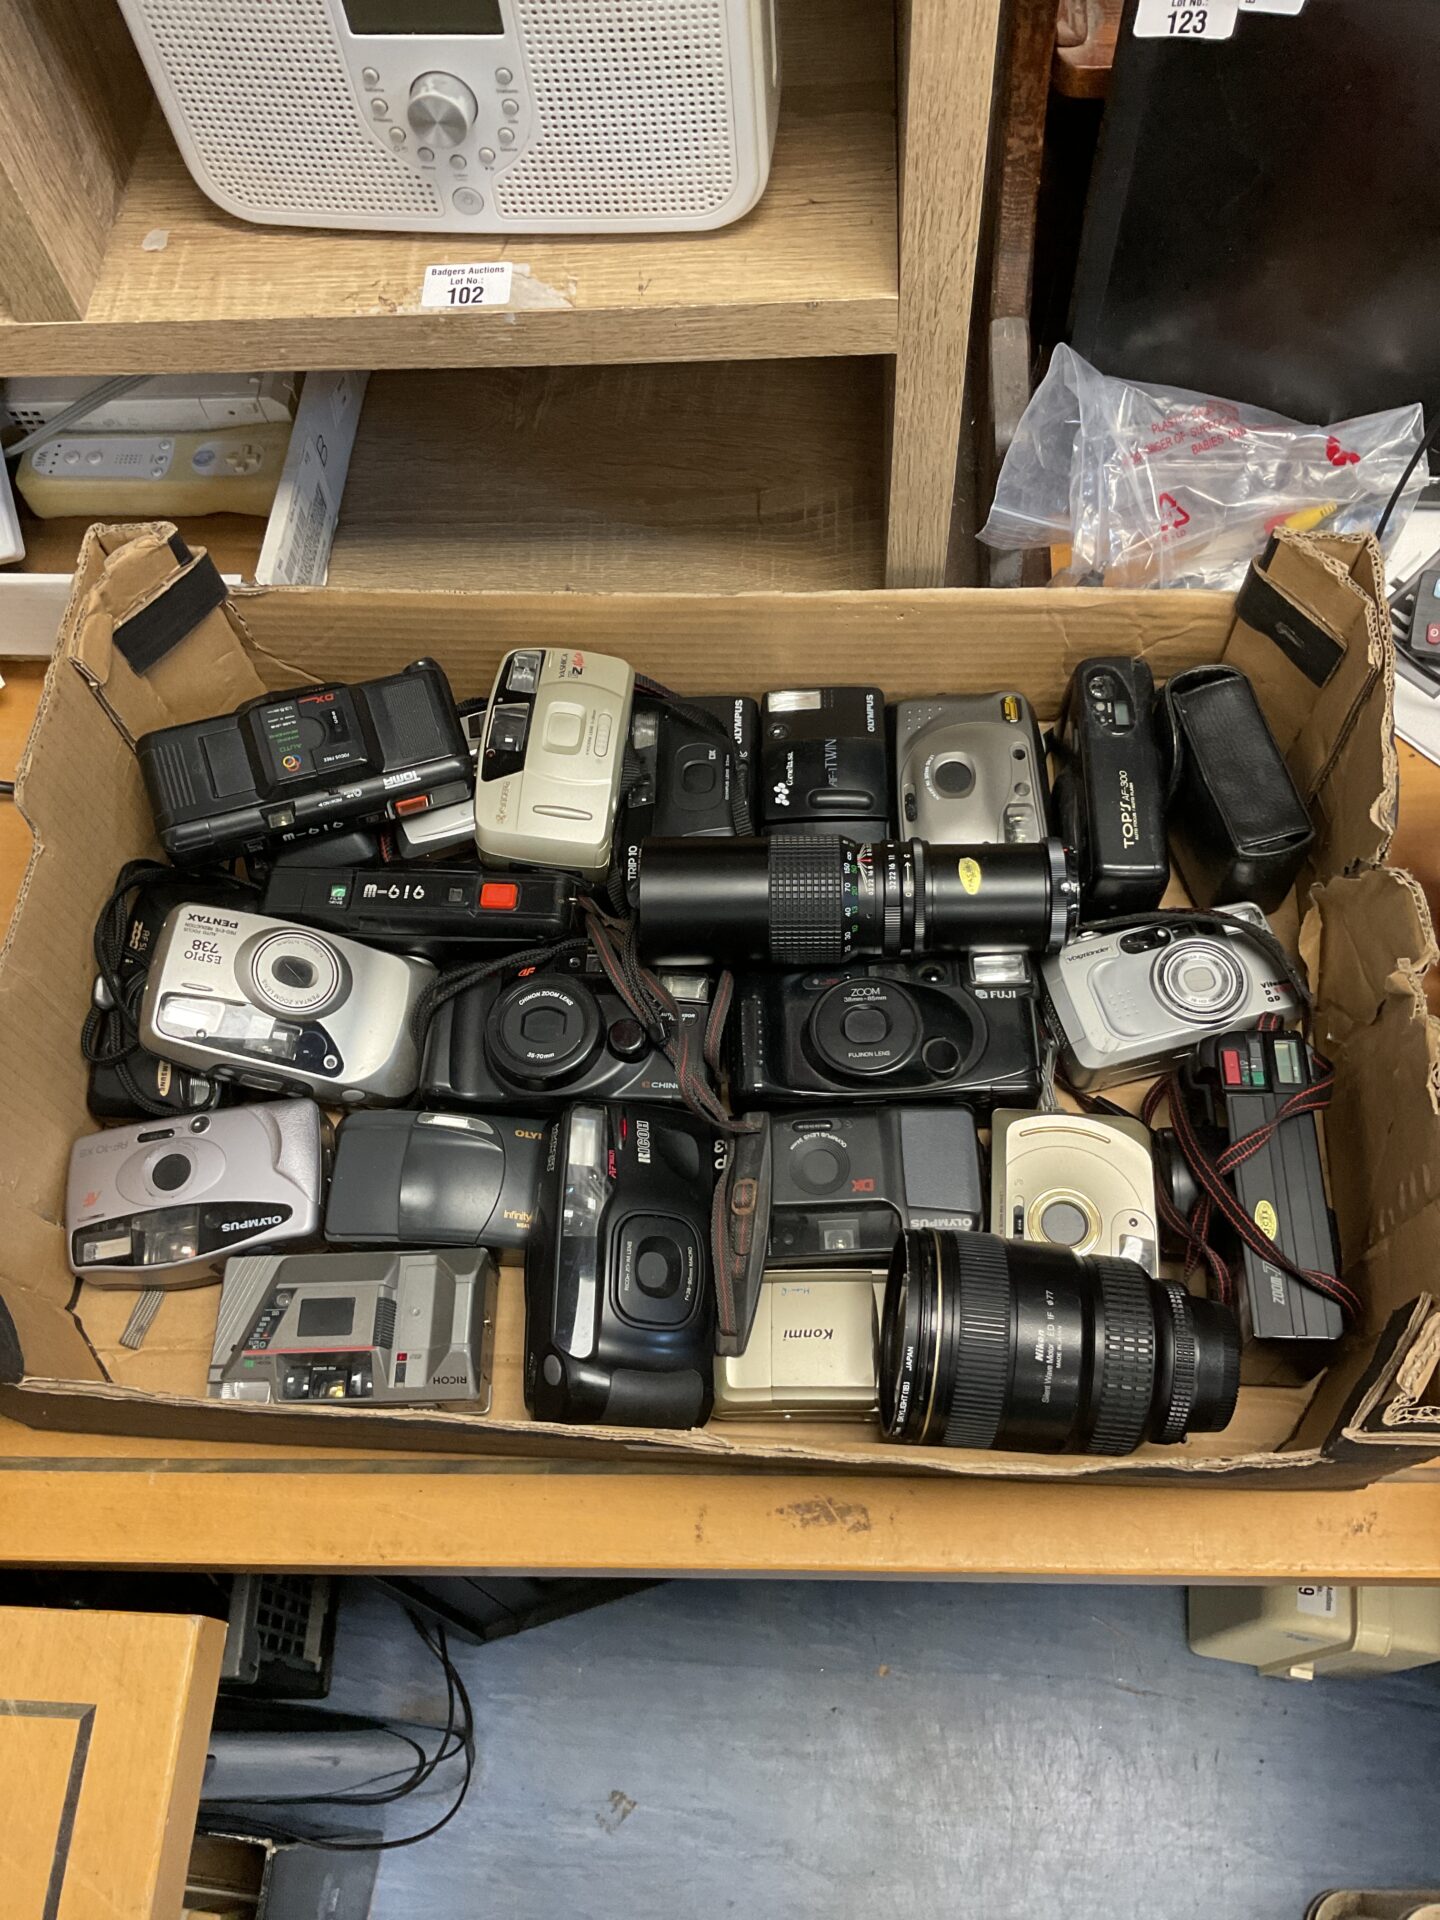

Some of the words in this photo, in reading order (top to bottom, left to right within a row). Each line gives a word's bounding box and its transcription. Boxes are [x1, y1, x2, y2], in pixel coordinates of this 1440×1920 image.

[1167, 10, 1208, 34] 123
[431, 268, 466, 277] Badgers
[468, 266, 505, 275] Auctions
[447, 286, 484, 304] 102
[1192, 435, 1224, 455] BABIES
[558, 653, 568, 679] YASHICA
[866, 694, 875, 732] OLYMPUS
[825, 738, 837, 768] TWIN
[1119, 770, 1130, 801] AF-300
[1120, 801, 1135, 849] TOP'S
[628, 845, 638, 856] 10
[627, 857, 638, 880] TRIP
[889, 871, 896, 880] 22
[845, 882, 851, 892] 70
[851, 886, 858, 896] 20
[889, 881, 897, 890] 32
[845, 907, 852, 917] 40
[187, 913, 239, 929] PENTAX
[852, 924, 859, 933] 10
[845, 931, 851, 941] 30
[192, 939, 219, 954] 738
[184, 950, 222, 965] ESPIO
[518, 967, 536, 977] AF
[518, 992, 541, 1006] CHINON
[540, 990, 558, 999] ZOOM
[557, 991, 574, 1006] LENS
[850, 987, 881, 997] ZOOM
[990, 990, 1016, 1000] FUJI
[848, 1051, 873, 1059] FUJINON
[873, 1050, 891, 1058] LENS
[161, 1062, 169, 1092] MSUNG
[514, 1129, 542, 1140] OLY
[636, 1119, 651, 1164] RICOH
[802, 1132, 821, 1142] LENS
[821, 1132, 848, 1149] OLYMPUS
[221, 1215, 282, 1232] OLYMPUS
[503, 1210, 533, 1223] Infinity
[910, 1218, 973, 1228] OLYMPUS
[1047, 1311, 1055, 1320] IF
[783, 1328, 834, 1342] Konmi
[1046, 1324, 1055, 1337] ED
[1035, 1329, 1045, 1362] Nikon
[906, 1346, 914, 1371] JAPAN
[1046, 1343, 1054, 1364] Motor
[433, 1376, 467, 1385] RICOH
[1044, 1365, 1053, 1384] Wave
[896, 1394, 908, 1423] SKYLIGHT
